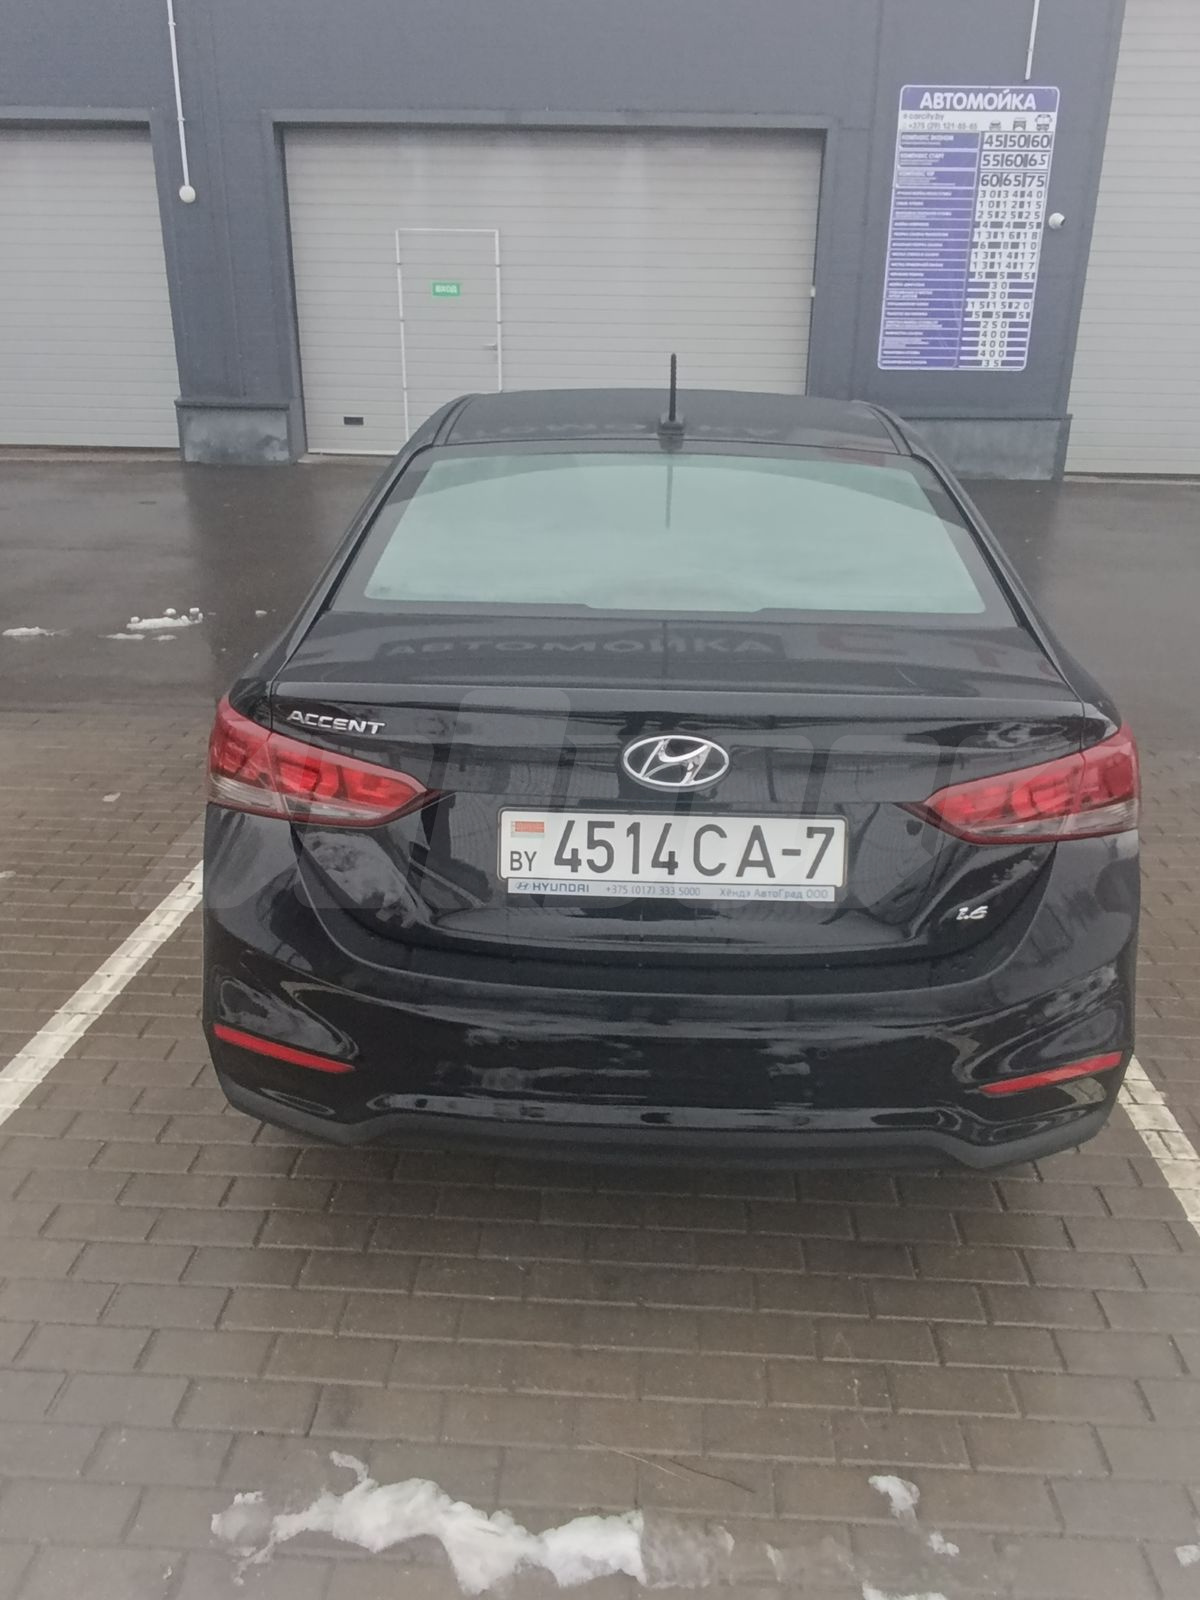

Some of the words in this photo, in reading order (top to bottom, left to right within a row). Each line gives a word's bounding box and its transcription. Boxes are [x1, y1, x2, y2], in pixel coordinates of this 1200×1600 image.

[920, 89, 1036, 110] АВТОМОЙКА
[985, 134, 1003, 147] 45
[1008, 135, 1026, 148] 50
[1031, 135, 1049, 148] 60
[982, 154, 1000, 166] 55
[1005, 154, 1023, 167] 60
[1029, 154, 1047, 166] 65
[981, 174, 999, 187] 60
[1003, 174, 1021, 187] 65
[1027, 176, 1044, 187] 75
[995, 311, 1000, 319] 5
[287, 710, 386, 735] ACCENT
[510, 851, 537, 872] BY
[532, 882, 589, 894] HYUNDAI
[606, 885, 628, 896] +375
[631, 886, 656, 897] (017)
[659, 886, 676, 896] 333
[678, 886, 701, 897] 5000
[754, 888, 803, 900] АвтоГрад
[806, 888, 828, 899] ООО
[956, 906, 988, 920] 1.6
